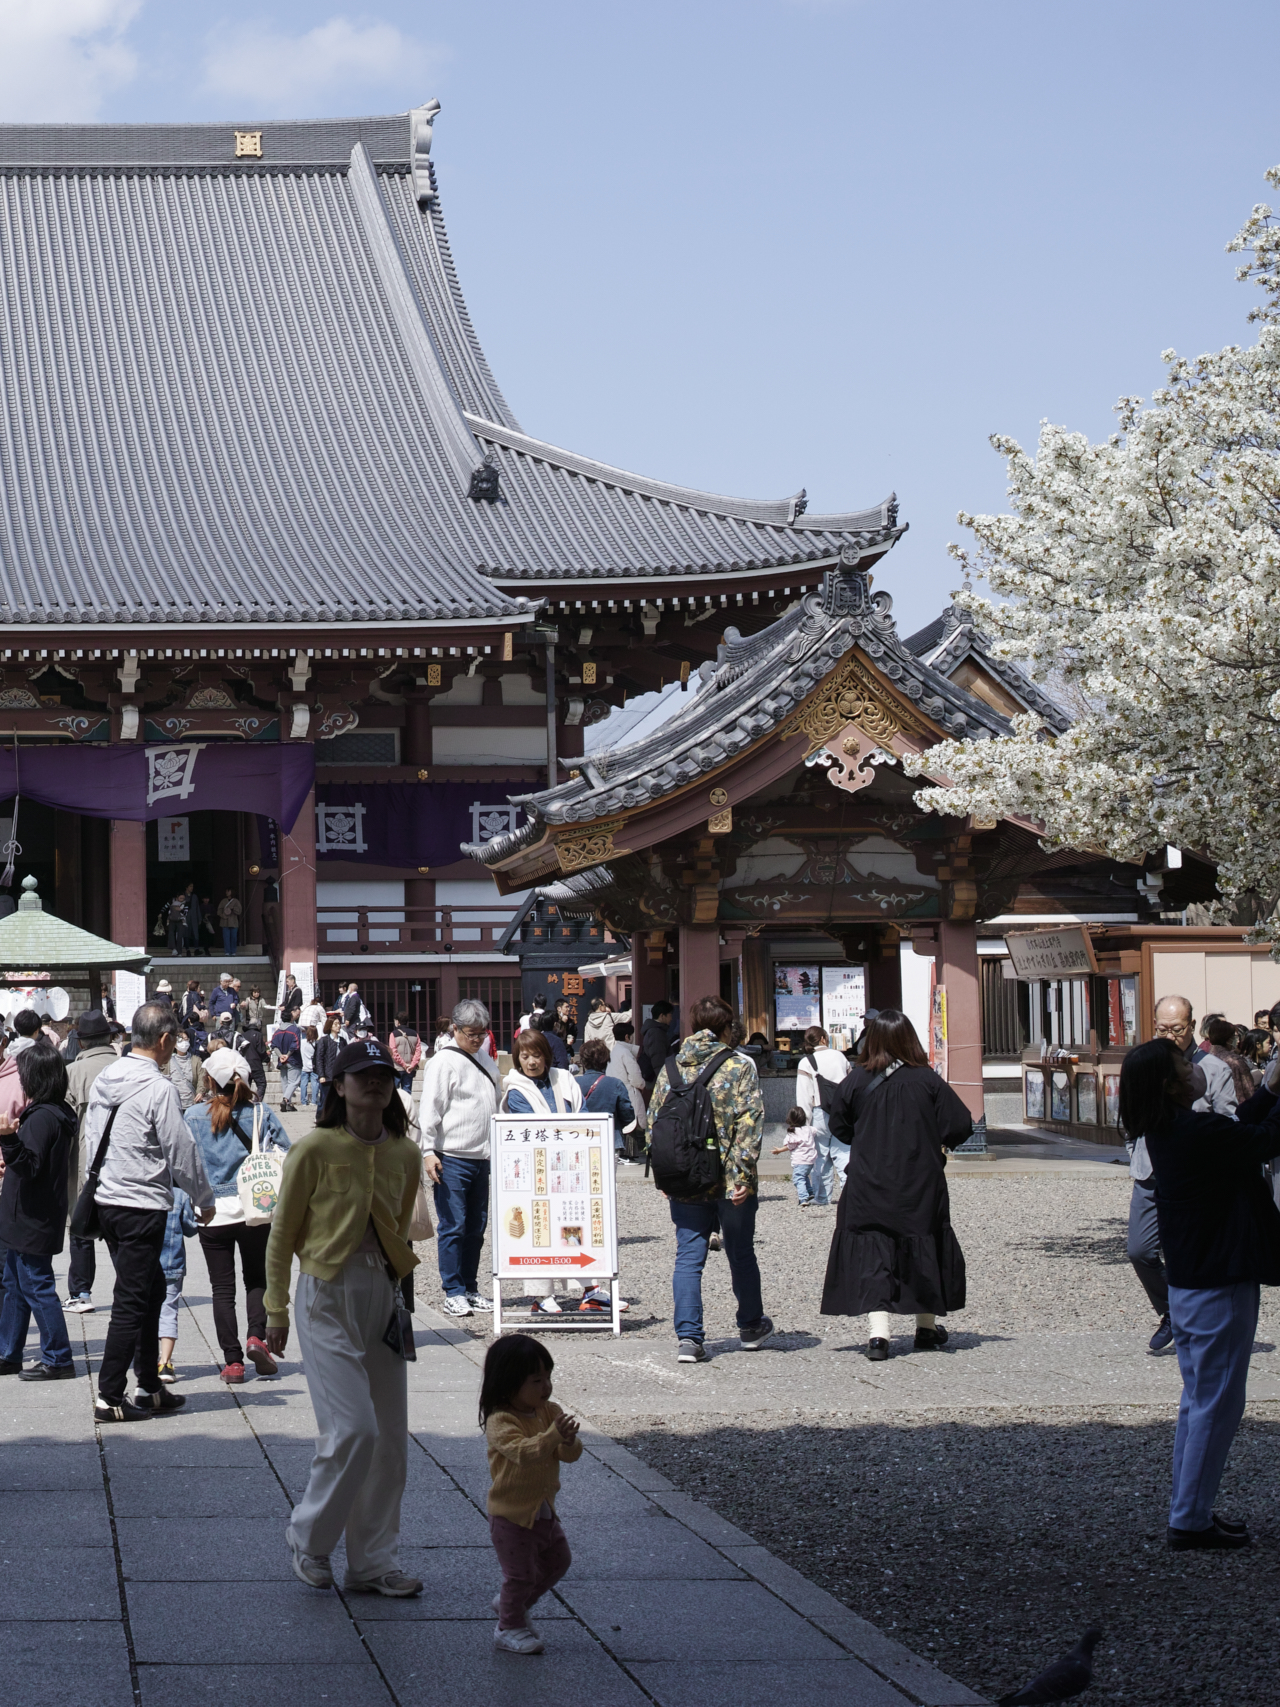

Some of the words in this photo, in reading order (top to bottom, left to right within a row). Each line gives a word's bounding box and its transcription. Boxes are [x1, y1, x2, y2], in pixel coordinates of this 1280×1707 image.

[364, 1042, 381, 1056] LA
[504, 1128, 595, 1143] 五重塔まつり
[242, 1170, 278, 1183] BANANAS
[536, 1149, 545, 1194] 限定御朱印
[592, 1201, 603, 1245] 五重塔特別祈願
